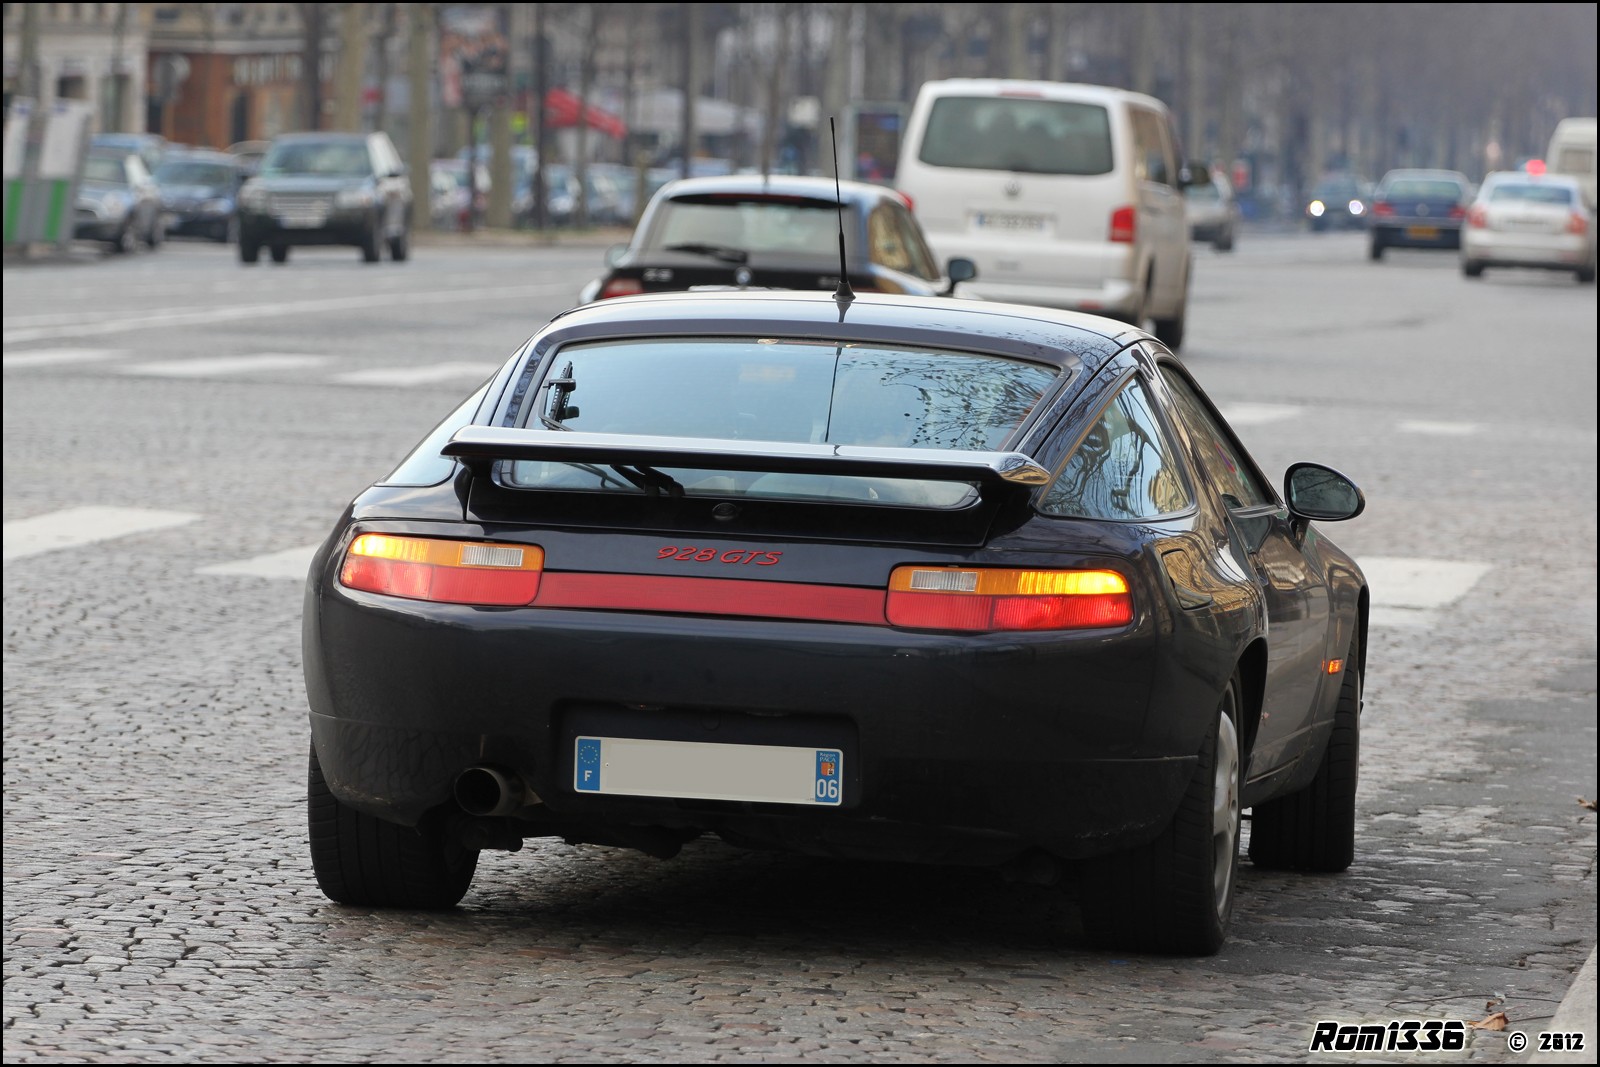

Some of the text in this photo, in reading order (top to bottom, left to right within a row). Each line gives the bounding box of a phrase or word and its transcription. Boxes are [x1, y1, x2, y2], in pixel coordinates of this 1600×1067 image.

[656, 545, 783, 566] 928 GTS
[584, 770, 592, 781] F
[816, 778, 838, 798] 06
